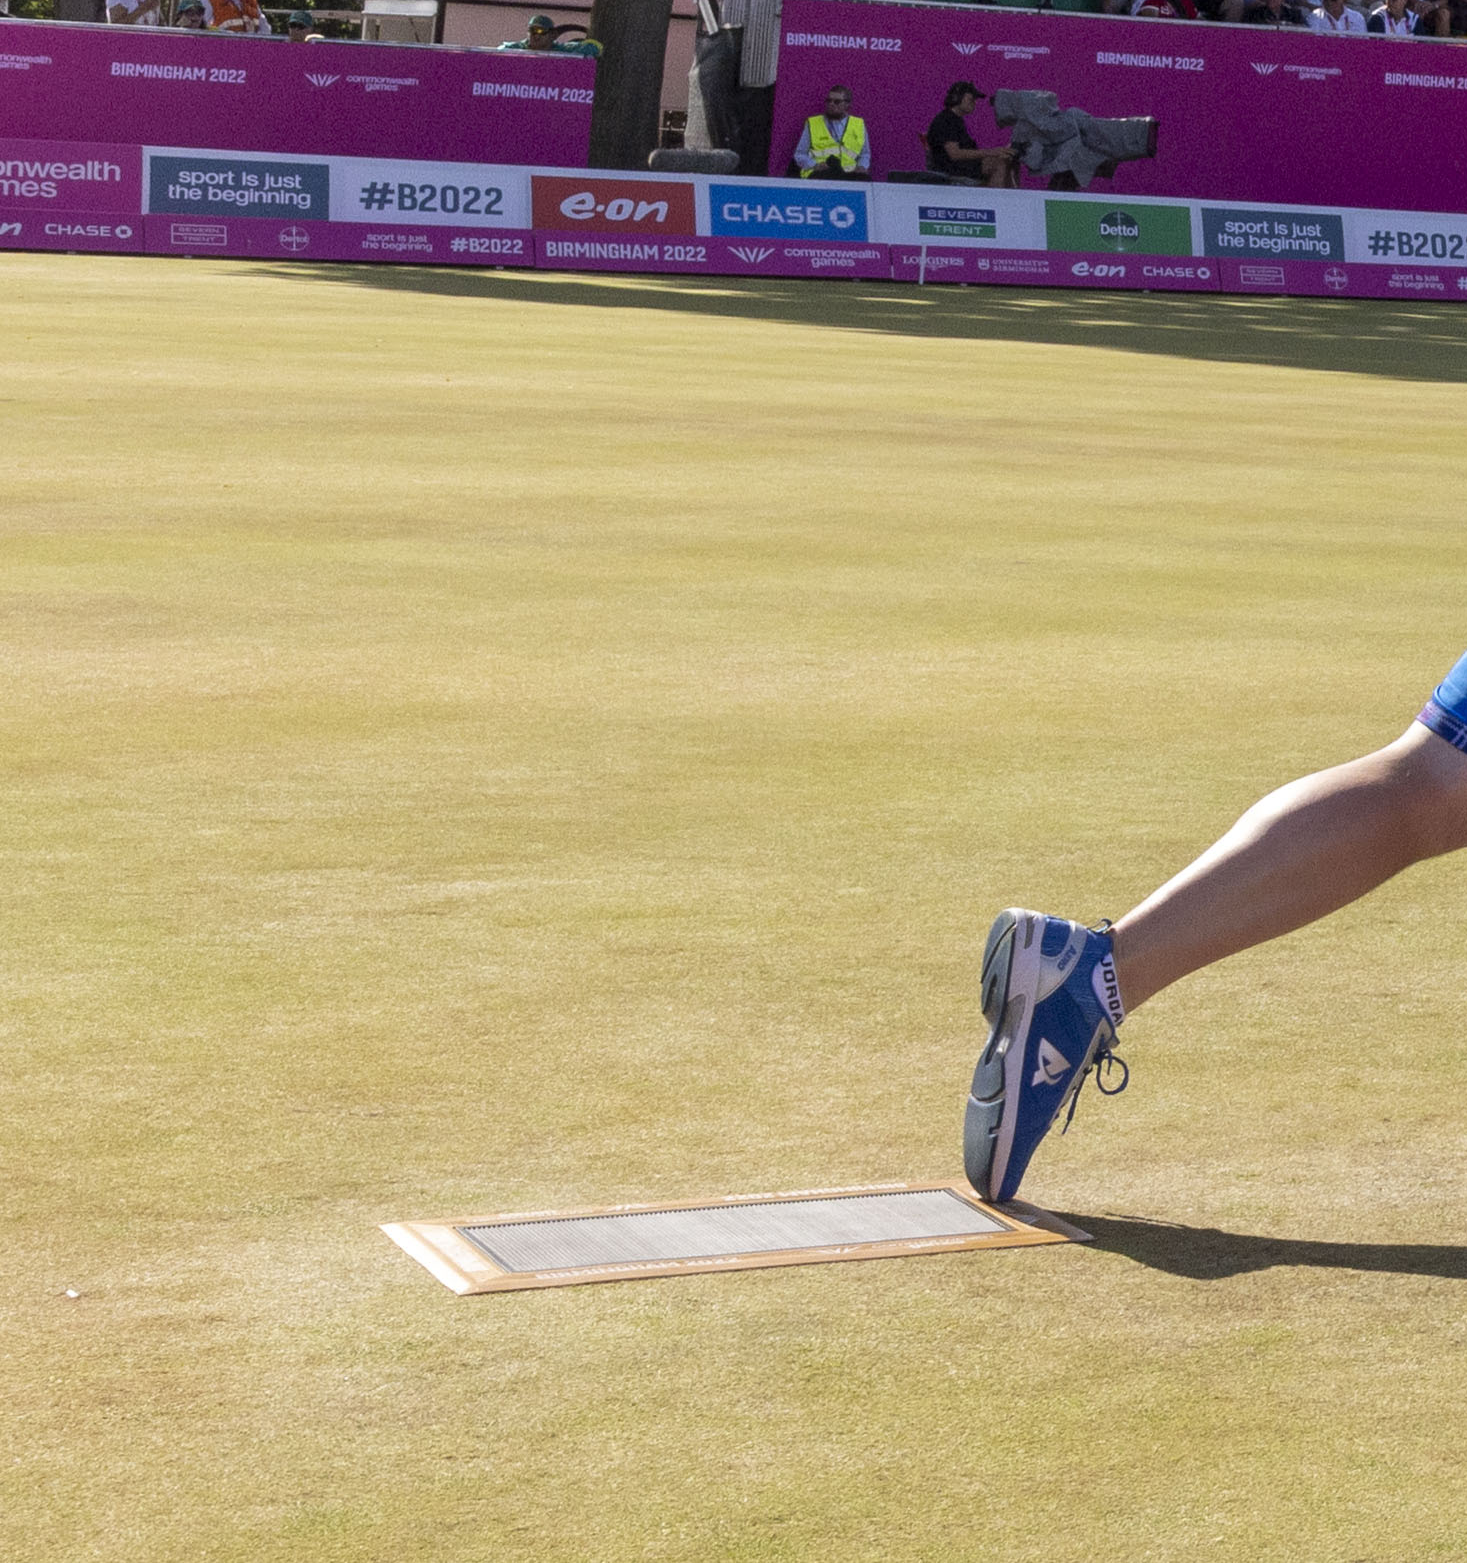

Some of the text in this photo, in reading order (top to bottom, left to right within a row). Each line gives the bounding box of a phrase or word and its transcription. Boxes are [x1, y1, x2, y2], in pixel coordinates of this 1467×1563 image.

[786, 32, 901, 52] BIRMINGHAM 2022
[1097, 51, 1205, 72] BIRMINGHAM 2022
[111, 62, 247, 84] BIRMINGHAM 2022
[1384, 72, 1455, 89] BIRMINGHAM
[472, 82, 594, 104] BIRMINGHAM 2022
[178, 169, 302, 189] sport is just
[168, 184, 312, 209] the beginning
[359, 181, 504, 215] #B2022
[722, 202, 824, 225] CHASE
[927, 209, 988, 220] SEVERN
[44, 223, 112, 236] CHASE
[933, 224, 983, 235] TRENT
[1100, 222, 1139, 237] Dettol
[1224, 219, 1322, 239] sport is just
[450, 237, 523, 254] #B2022
[545, 241, 707, 262] BIRMINGHAM 2022
[784, 247, 881, 260] commonwealth
[1217, 233, 1330, 255] the beginning
[812, 257, 856, 268] games
[1143, 265, 1194, 278] CHASE
